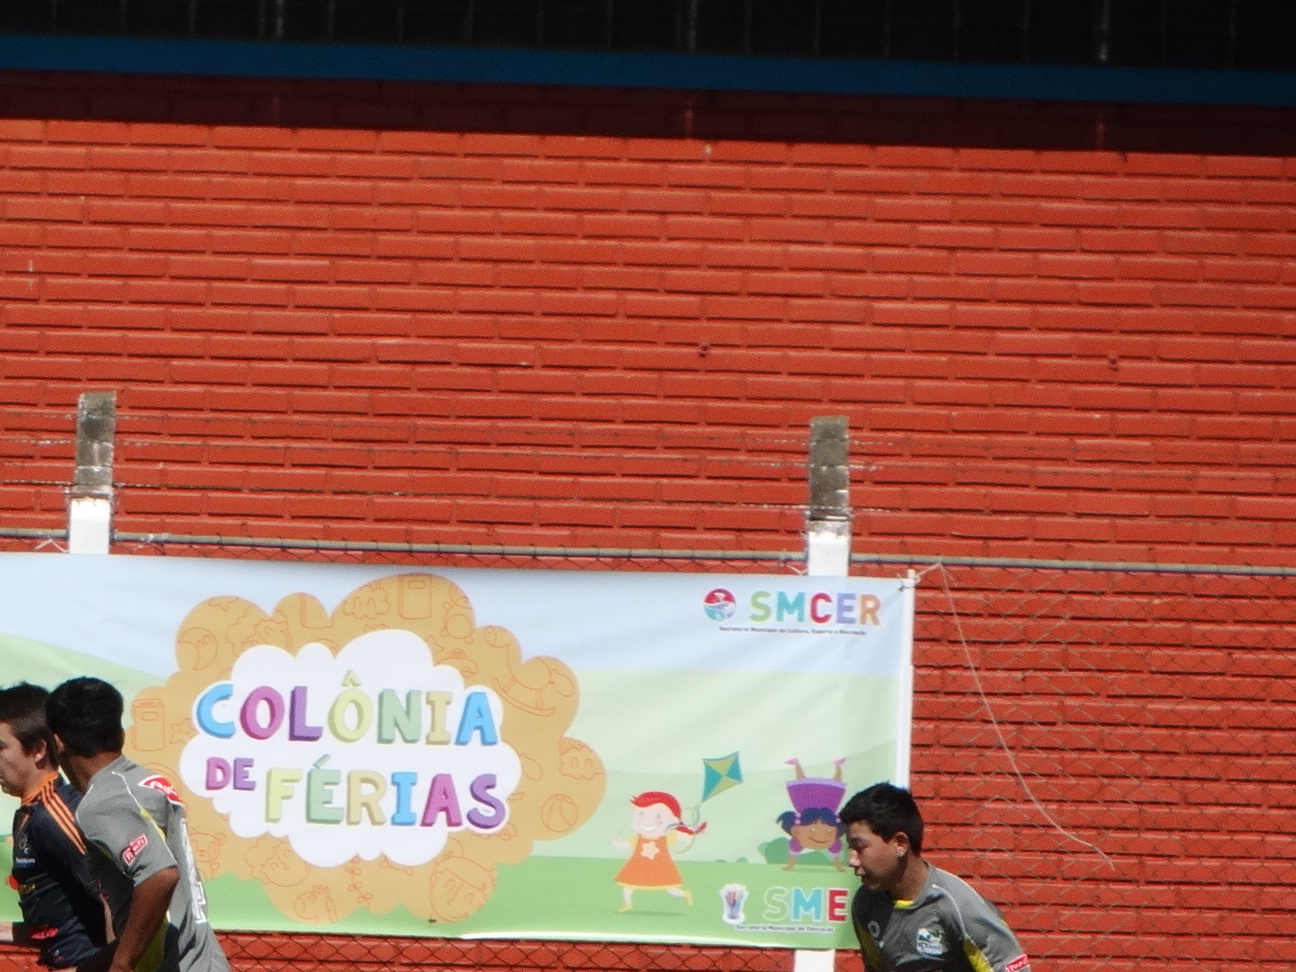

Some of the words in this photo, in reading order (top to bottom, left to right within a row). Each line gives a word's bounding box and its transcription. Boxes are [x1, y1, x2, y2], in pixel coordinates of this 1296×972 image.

[749, 590, 882, 626] SMCER
[195, 670, 498, 746] COLÔNIA
[205, 756, 257, 792] DE
[265, 754, 506, 829] FÉRIAS
[762, 886, 849, 923] SME
